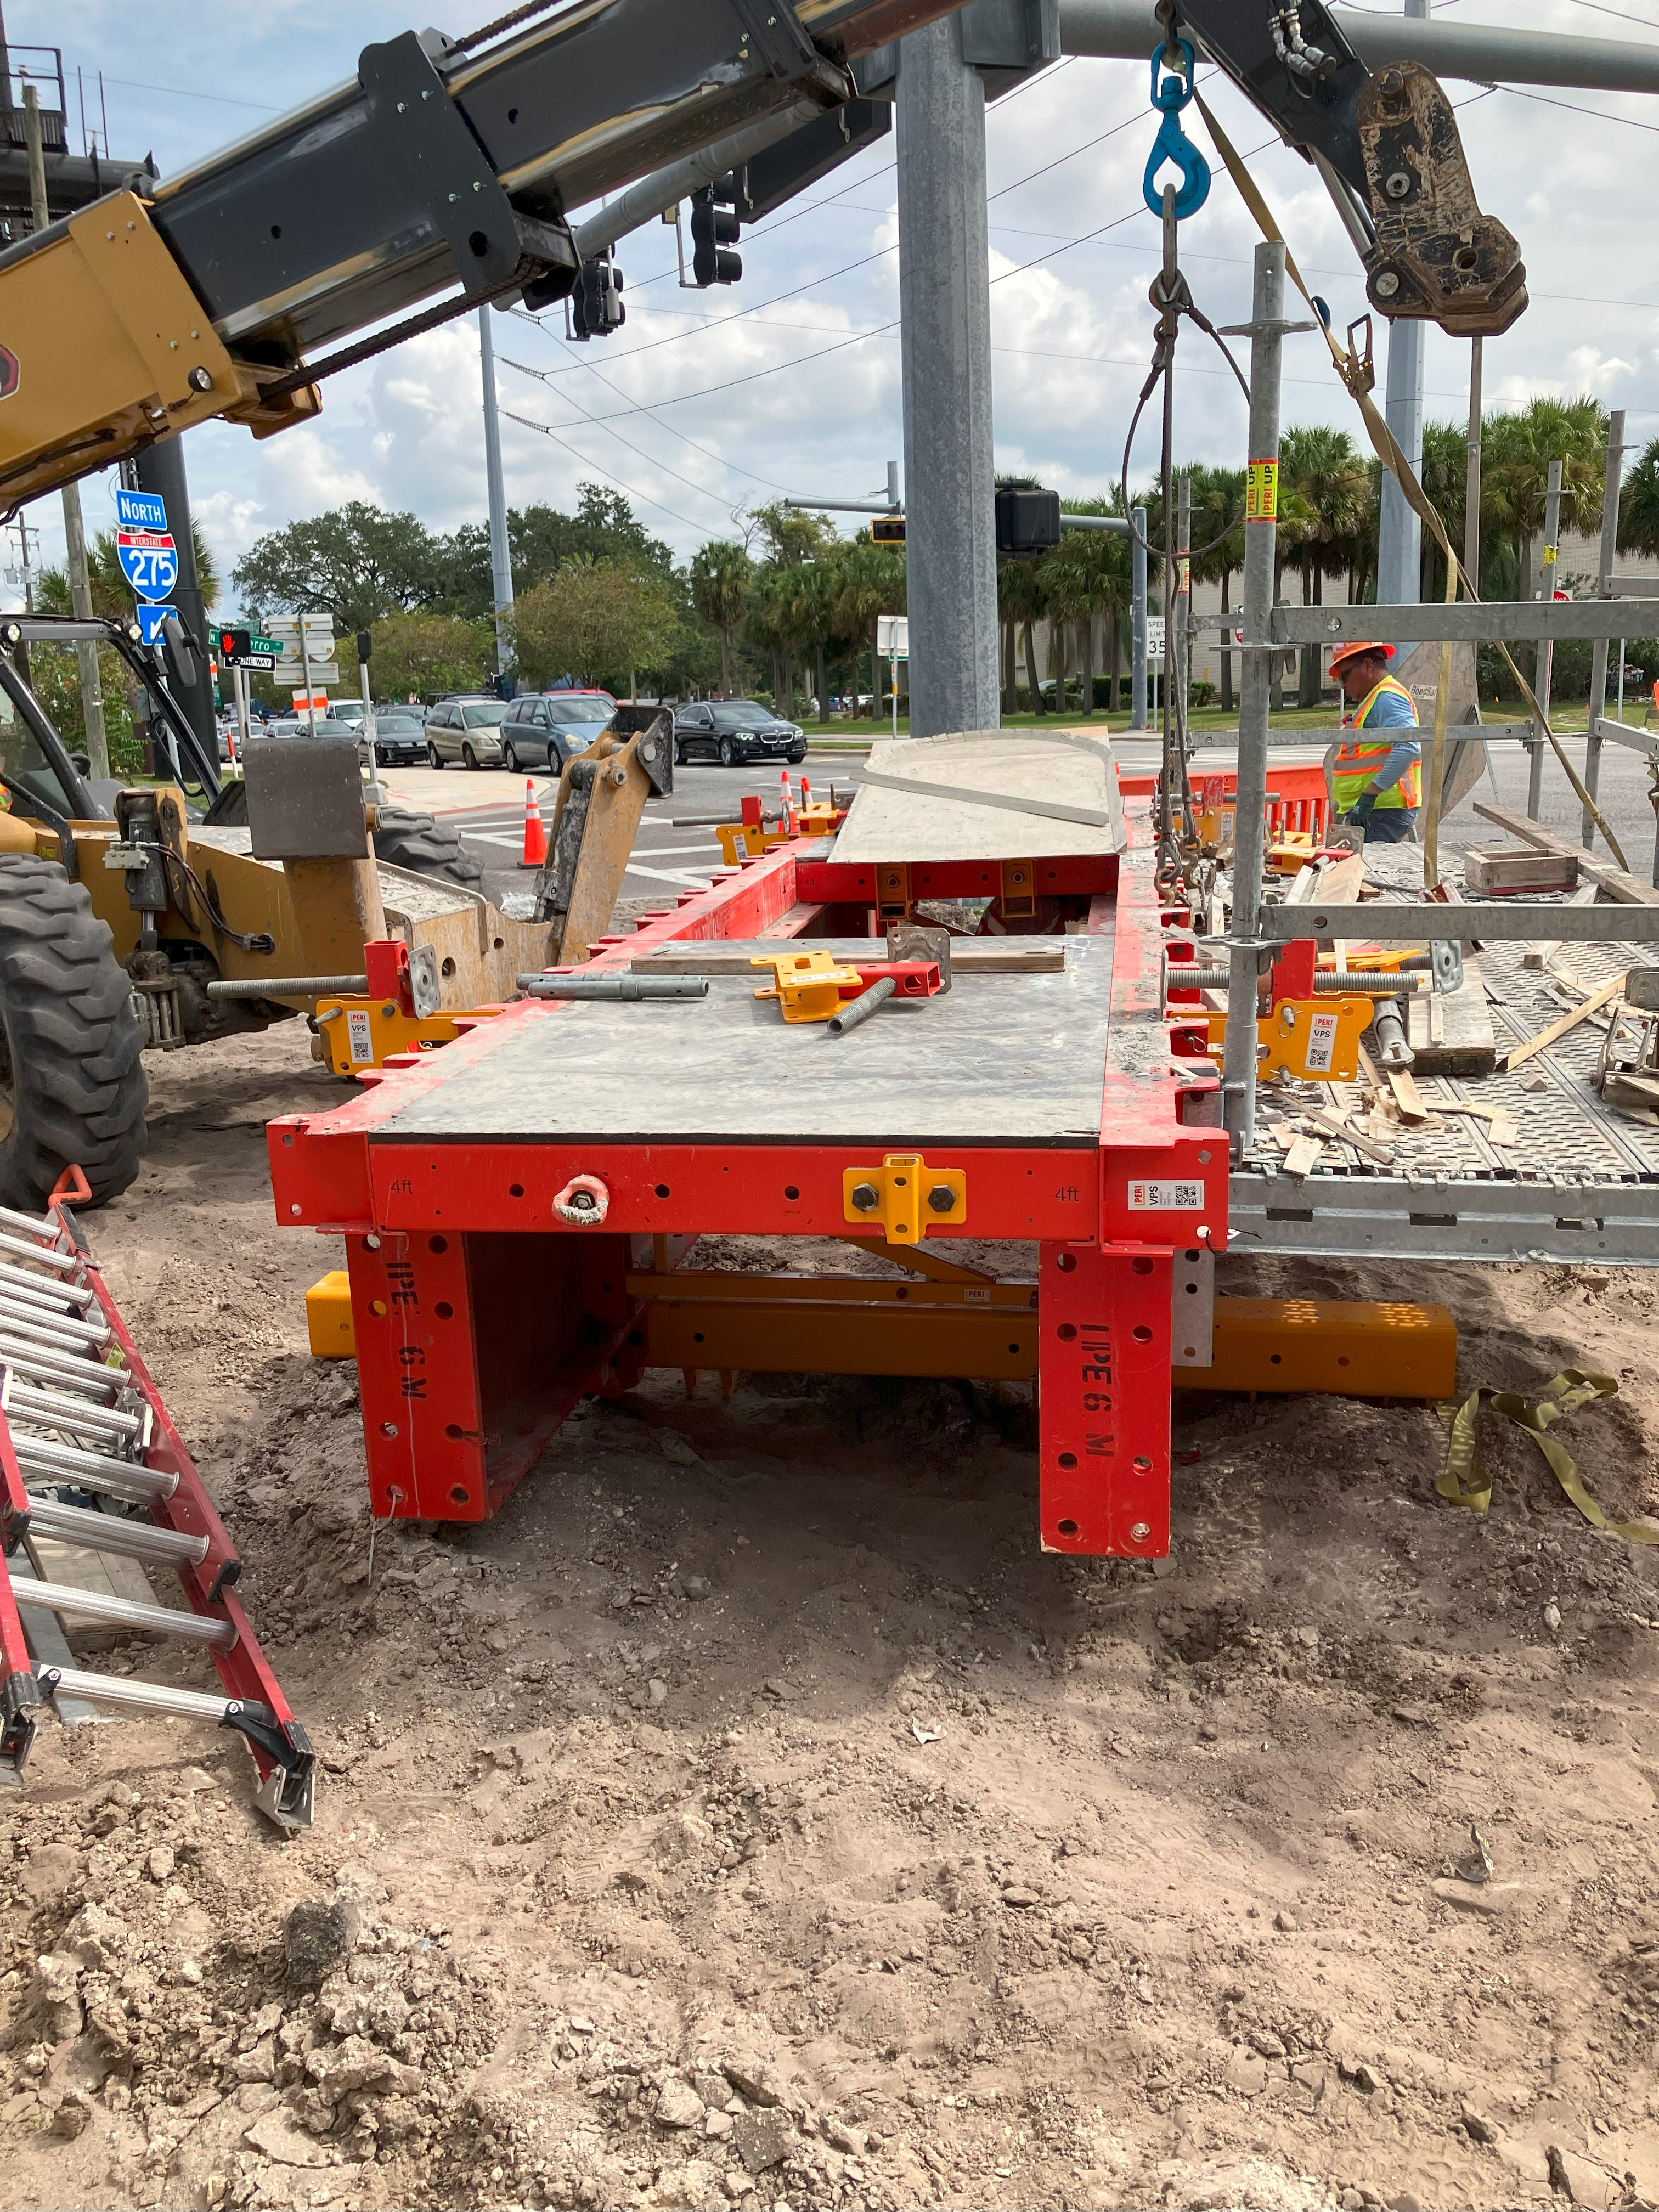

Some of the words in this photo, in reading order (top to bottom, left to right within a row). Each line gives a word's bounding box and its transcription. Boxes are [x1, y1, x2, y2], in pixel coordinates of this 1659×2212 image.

[1248, 466, 1255, 485] UP
[1264, 465, 1273, 484] UP
[1263, 488, 1272, 511] PERI
[129, 536, 162, 547] INTERSTATE
[129, 549, 176, 587] 275
[211, 633, 216, 642] N
[391, 1179, 413, 1194] 4ft
[1054, 1186, 1079, 1201] 4ft
[1134, 1186, 1142, 1203] PERI
[1149, 1186, 1158, 1205] VPS
